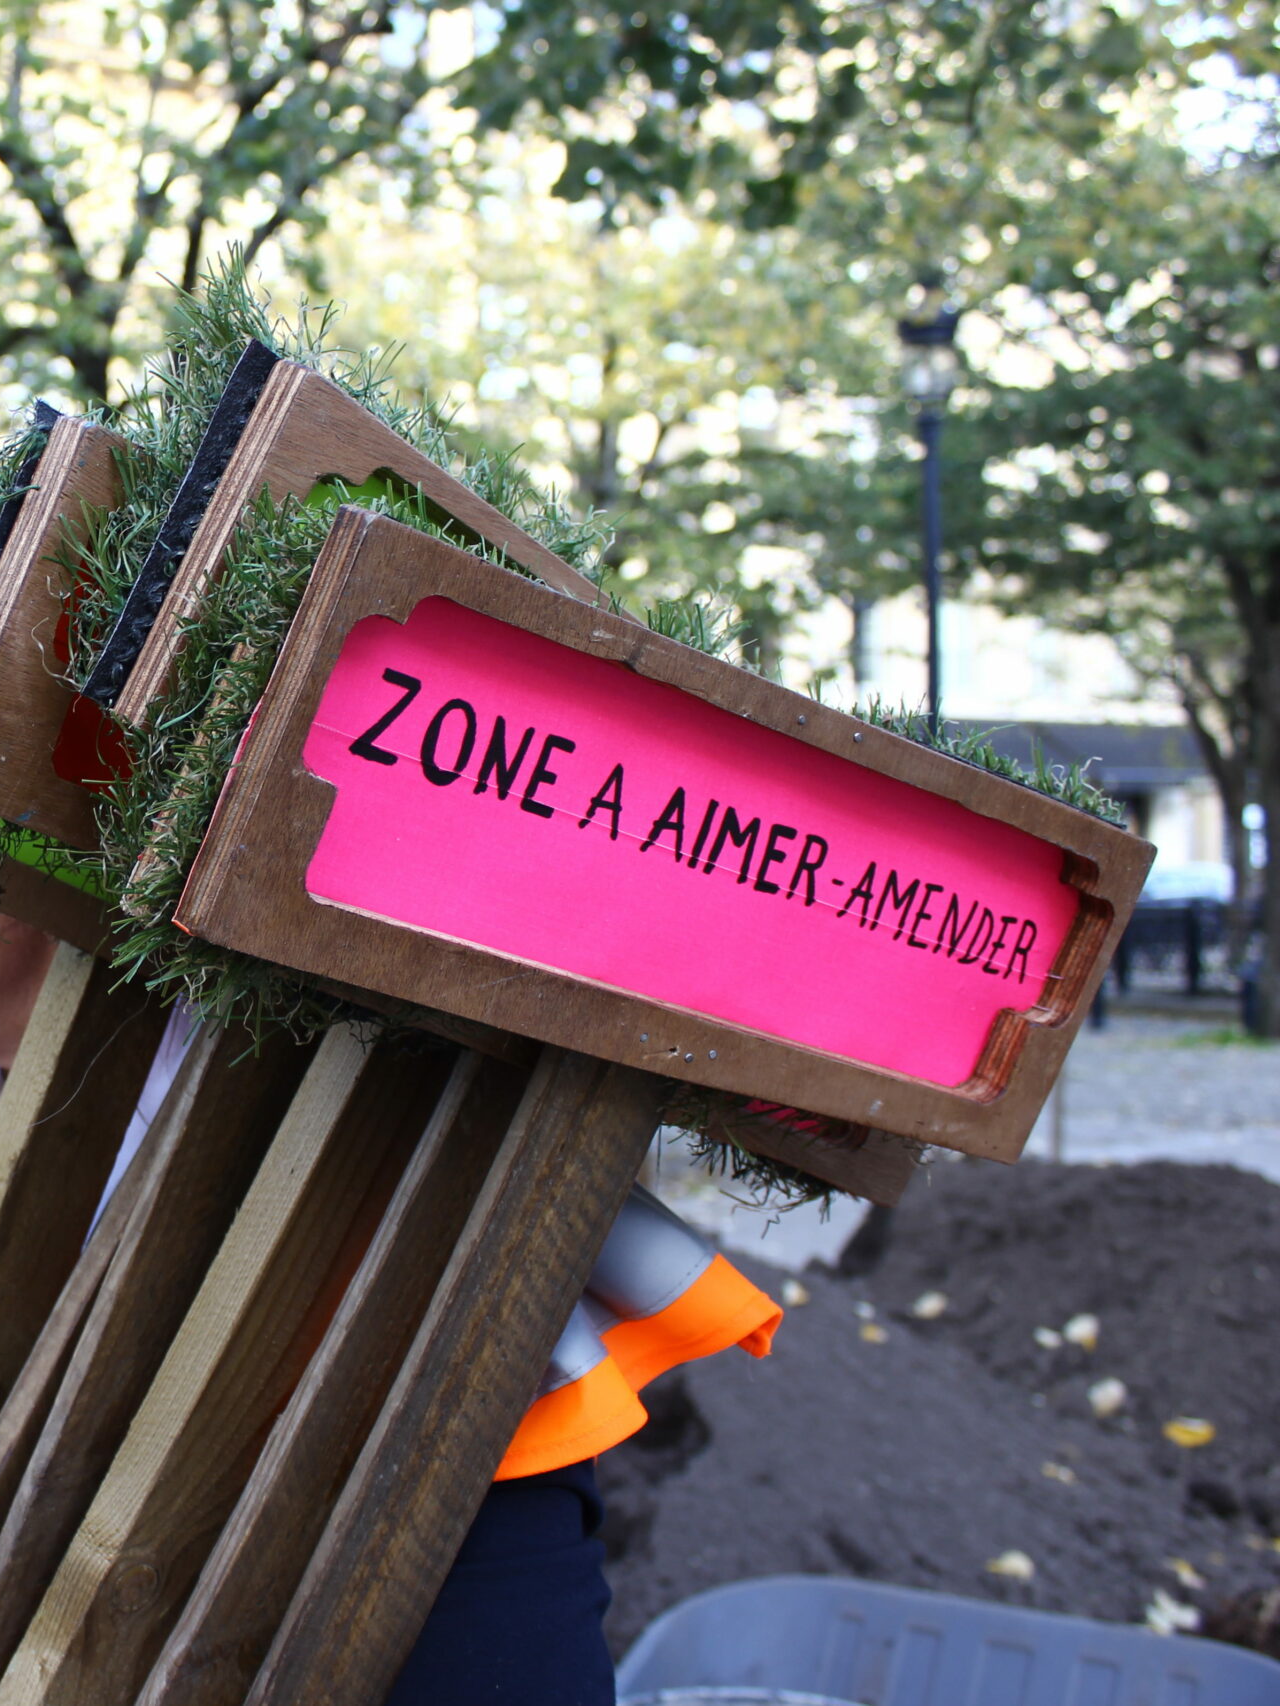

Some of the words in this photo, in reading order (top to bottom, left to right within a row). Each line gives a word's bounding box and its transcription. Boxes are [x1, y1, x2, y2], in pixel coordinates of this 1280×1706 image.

[349, 668, 575, 817] ZONE
[578, 764, 624, 840] A
[640, 787, 1037, 983] AIMER-AMENDER
